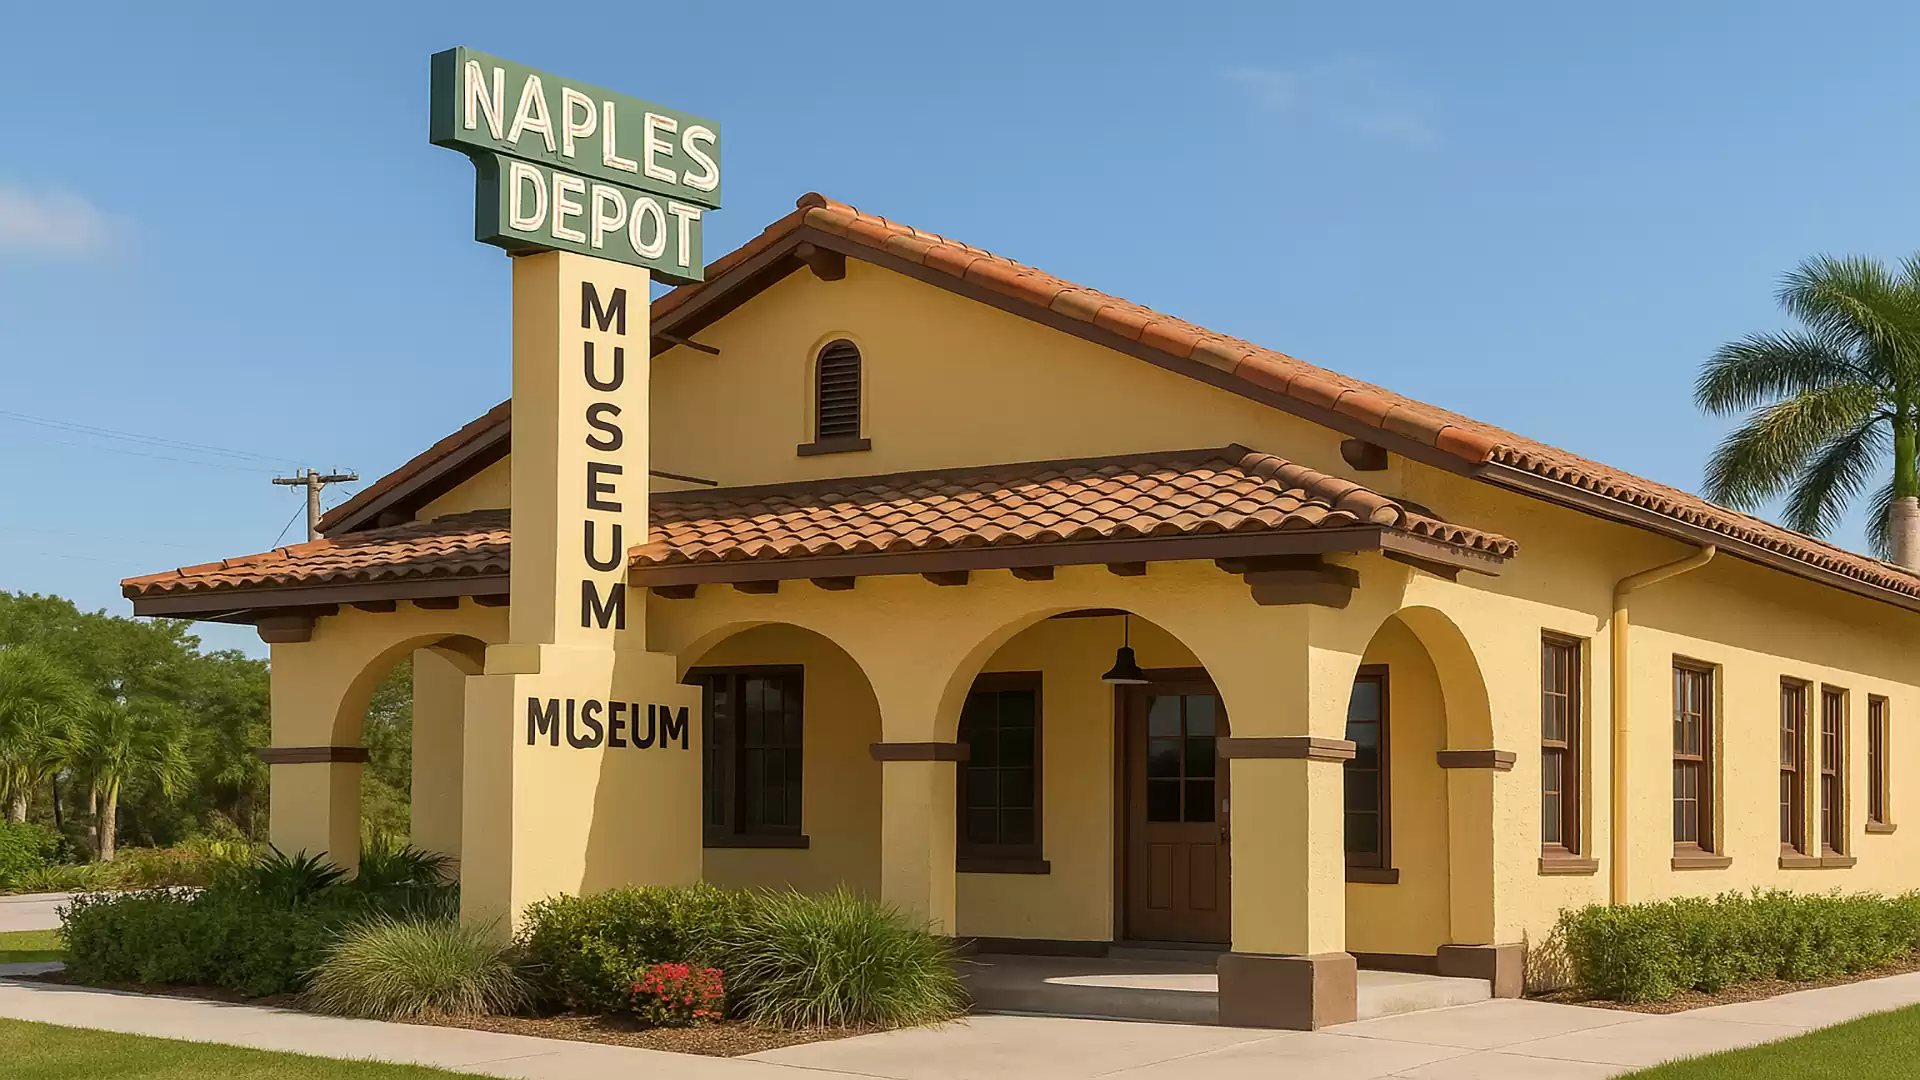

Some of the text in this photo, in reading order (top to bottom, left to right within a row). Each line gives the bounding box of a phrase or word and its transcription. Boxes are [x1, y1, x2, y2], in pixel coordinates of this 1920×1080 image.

[463, 59, 720, 193] NAPLES
[508, 161, 701, 268] DEPOT
[580, 280, 627, 630] MUSEUM
